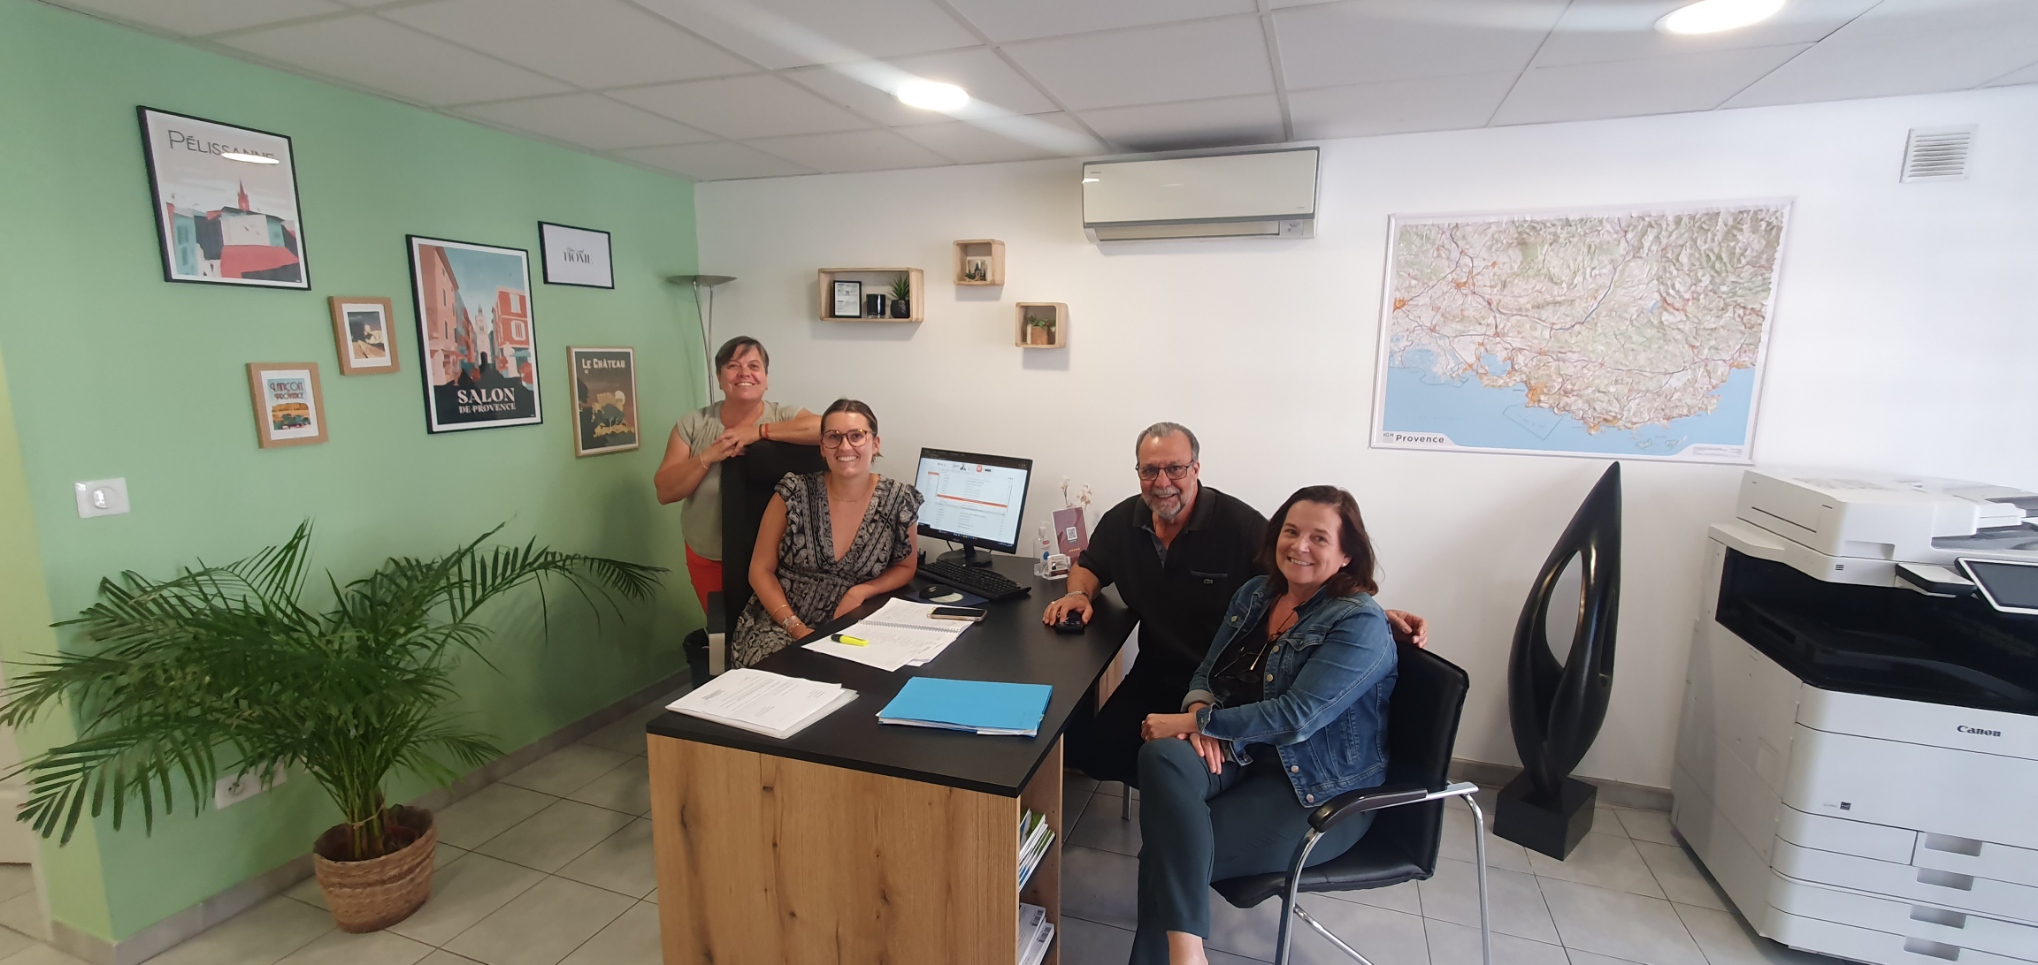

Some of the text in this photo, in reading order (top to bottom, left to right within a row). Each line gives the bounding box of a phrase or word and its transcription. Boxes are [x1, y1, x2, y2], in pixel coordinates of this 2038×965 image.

[457, 387, 515, 405] SALON
[1396, 434, 1444, 444] Provence
[1957, 725, 2001, 737] Canon
